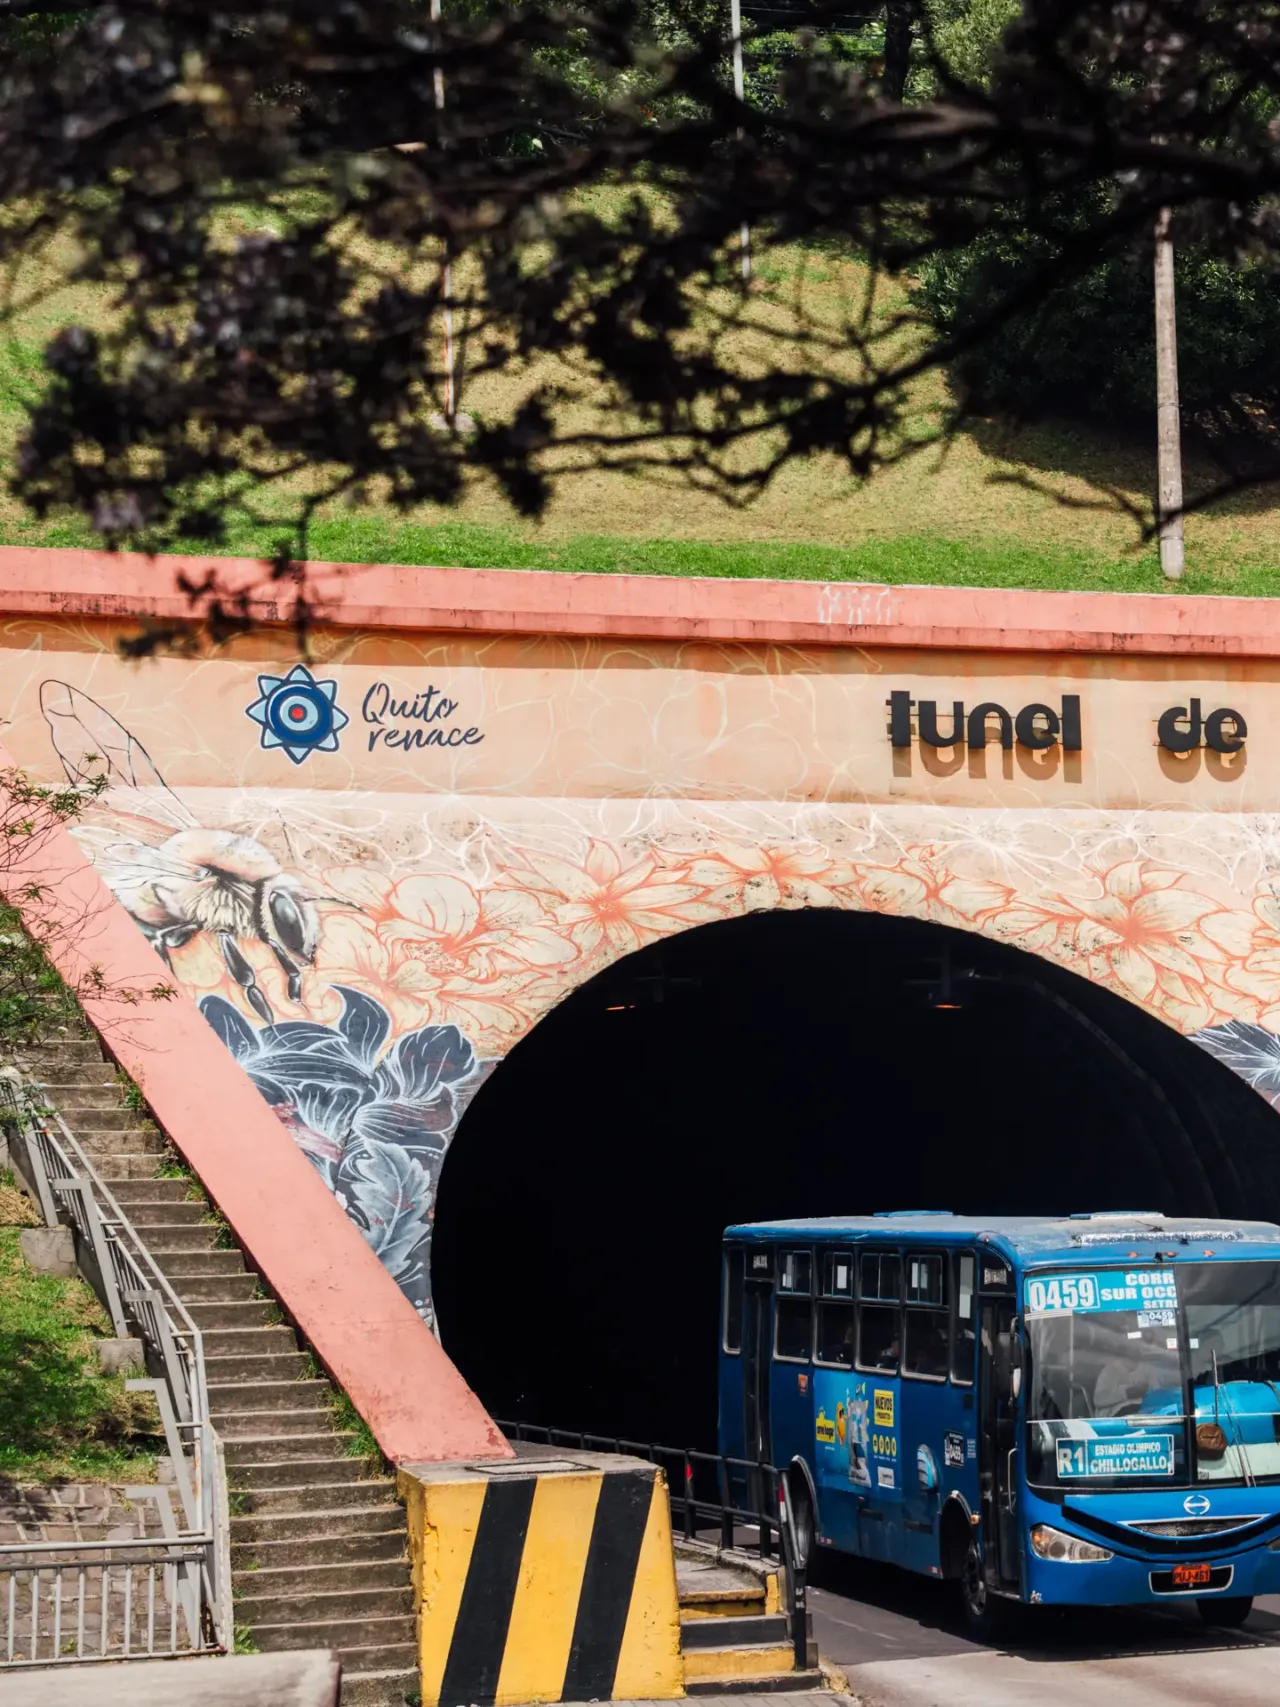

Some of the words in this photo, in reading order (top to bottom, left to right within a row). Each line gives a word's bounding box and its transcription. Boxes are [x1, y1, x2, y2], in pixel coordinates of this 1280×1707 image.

[362, 682, 458, 724] Quito
[367, 722, 485, 752] renace
[1157, 698, 1248, 753] de
[1029, 1277, 1096, 1312] 0459
[1100, 1287, 1138, 1301] SUR
[1141, 1286, 1177, 1299] OCC
[1149, 1311, 1174, 1321] 0459
[1058, 1447, 1084, 1473] R1
[1095, 1444, 1125, 1456] ESTADIO
[1126, 1442, 1161, 1454] OLIMPICO
[1090, 1456, 1167, 1473] CHILLOGALLO
